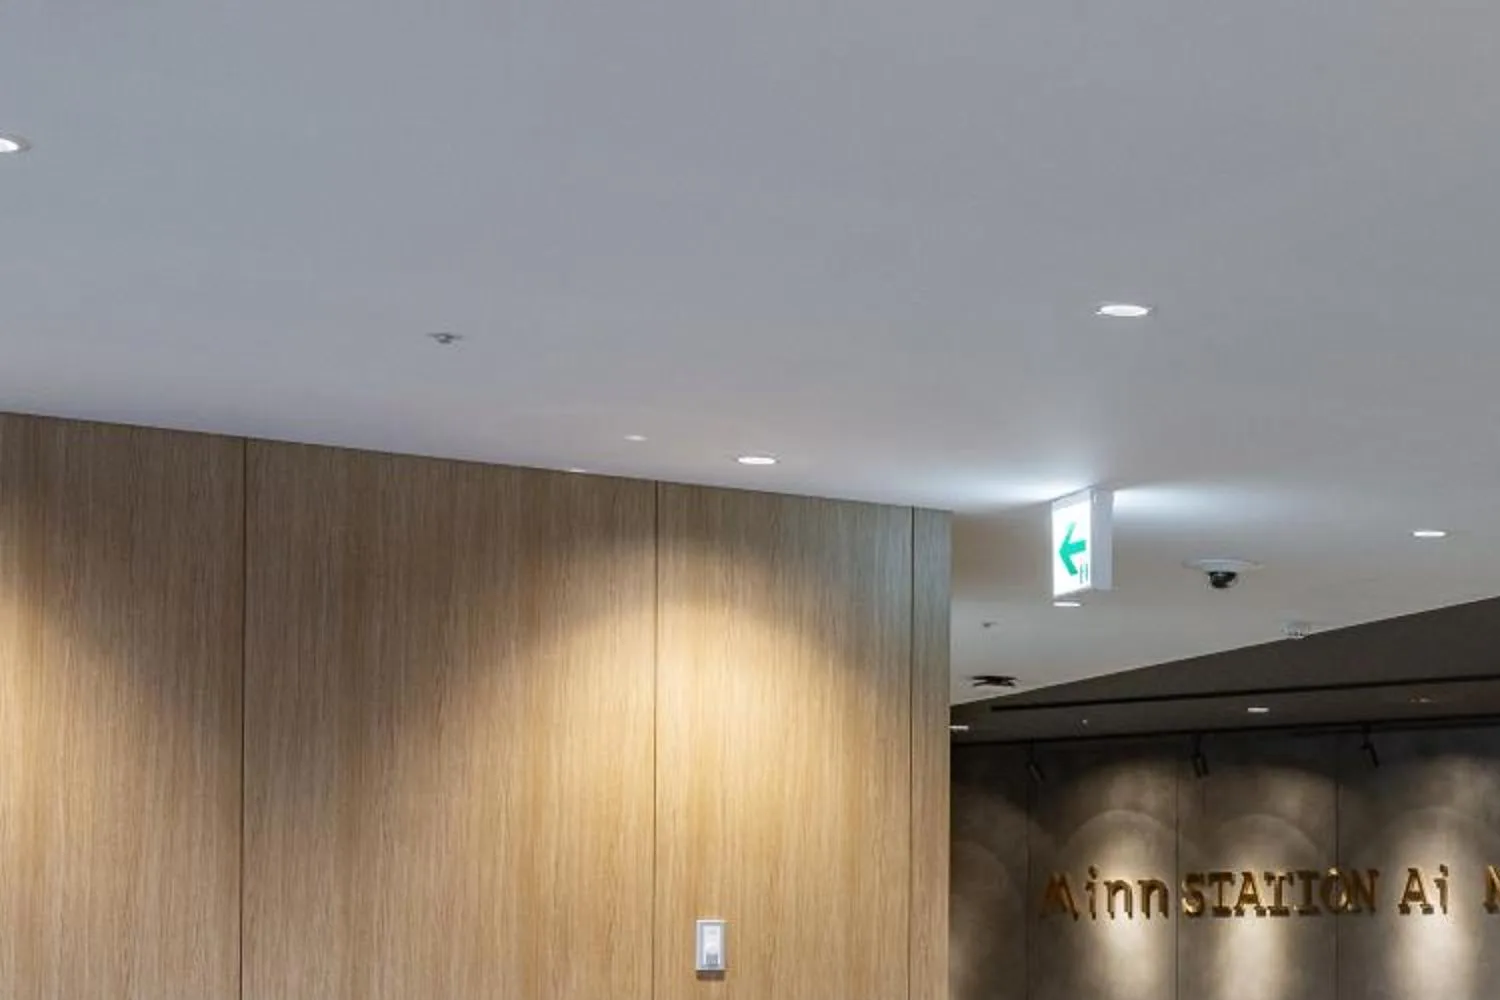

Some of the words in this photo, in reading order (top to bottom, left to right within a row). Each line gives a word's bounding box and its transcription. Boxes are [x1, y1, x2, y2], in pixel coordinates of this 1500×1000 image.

[1040, 865, 1169, 920] Minn
[1181, 868, 1379, 917] STATION
[1398, 864, 1449, 915] Ai
